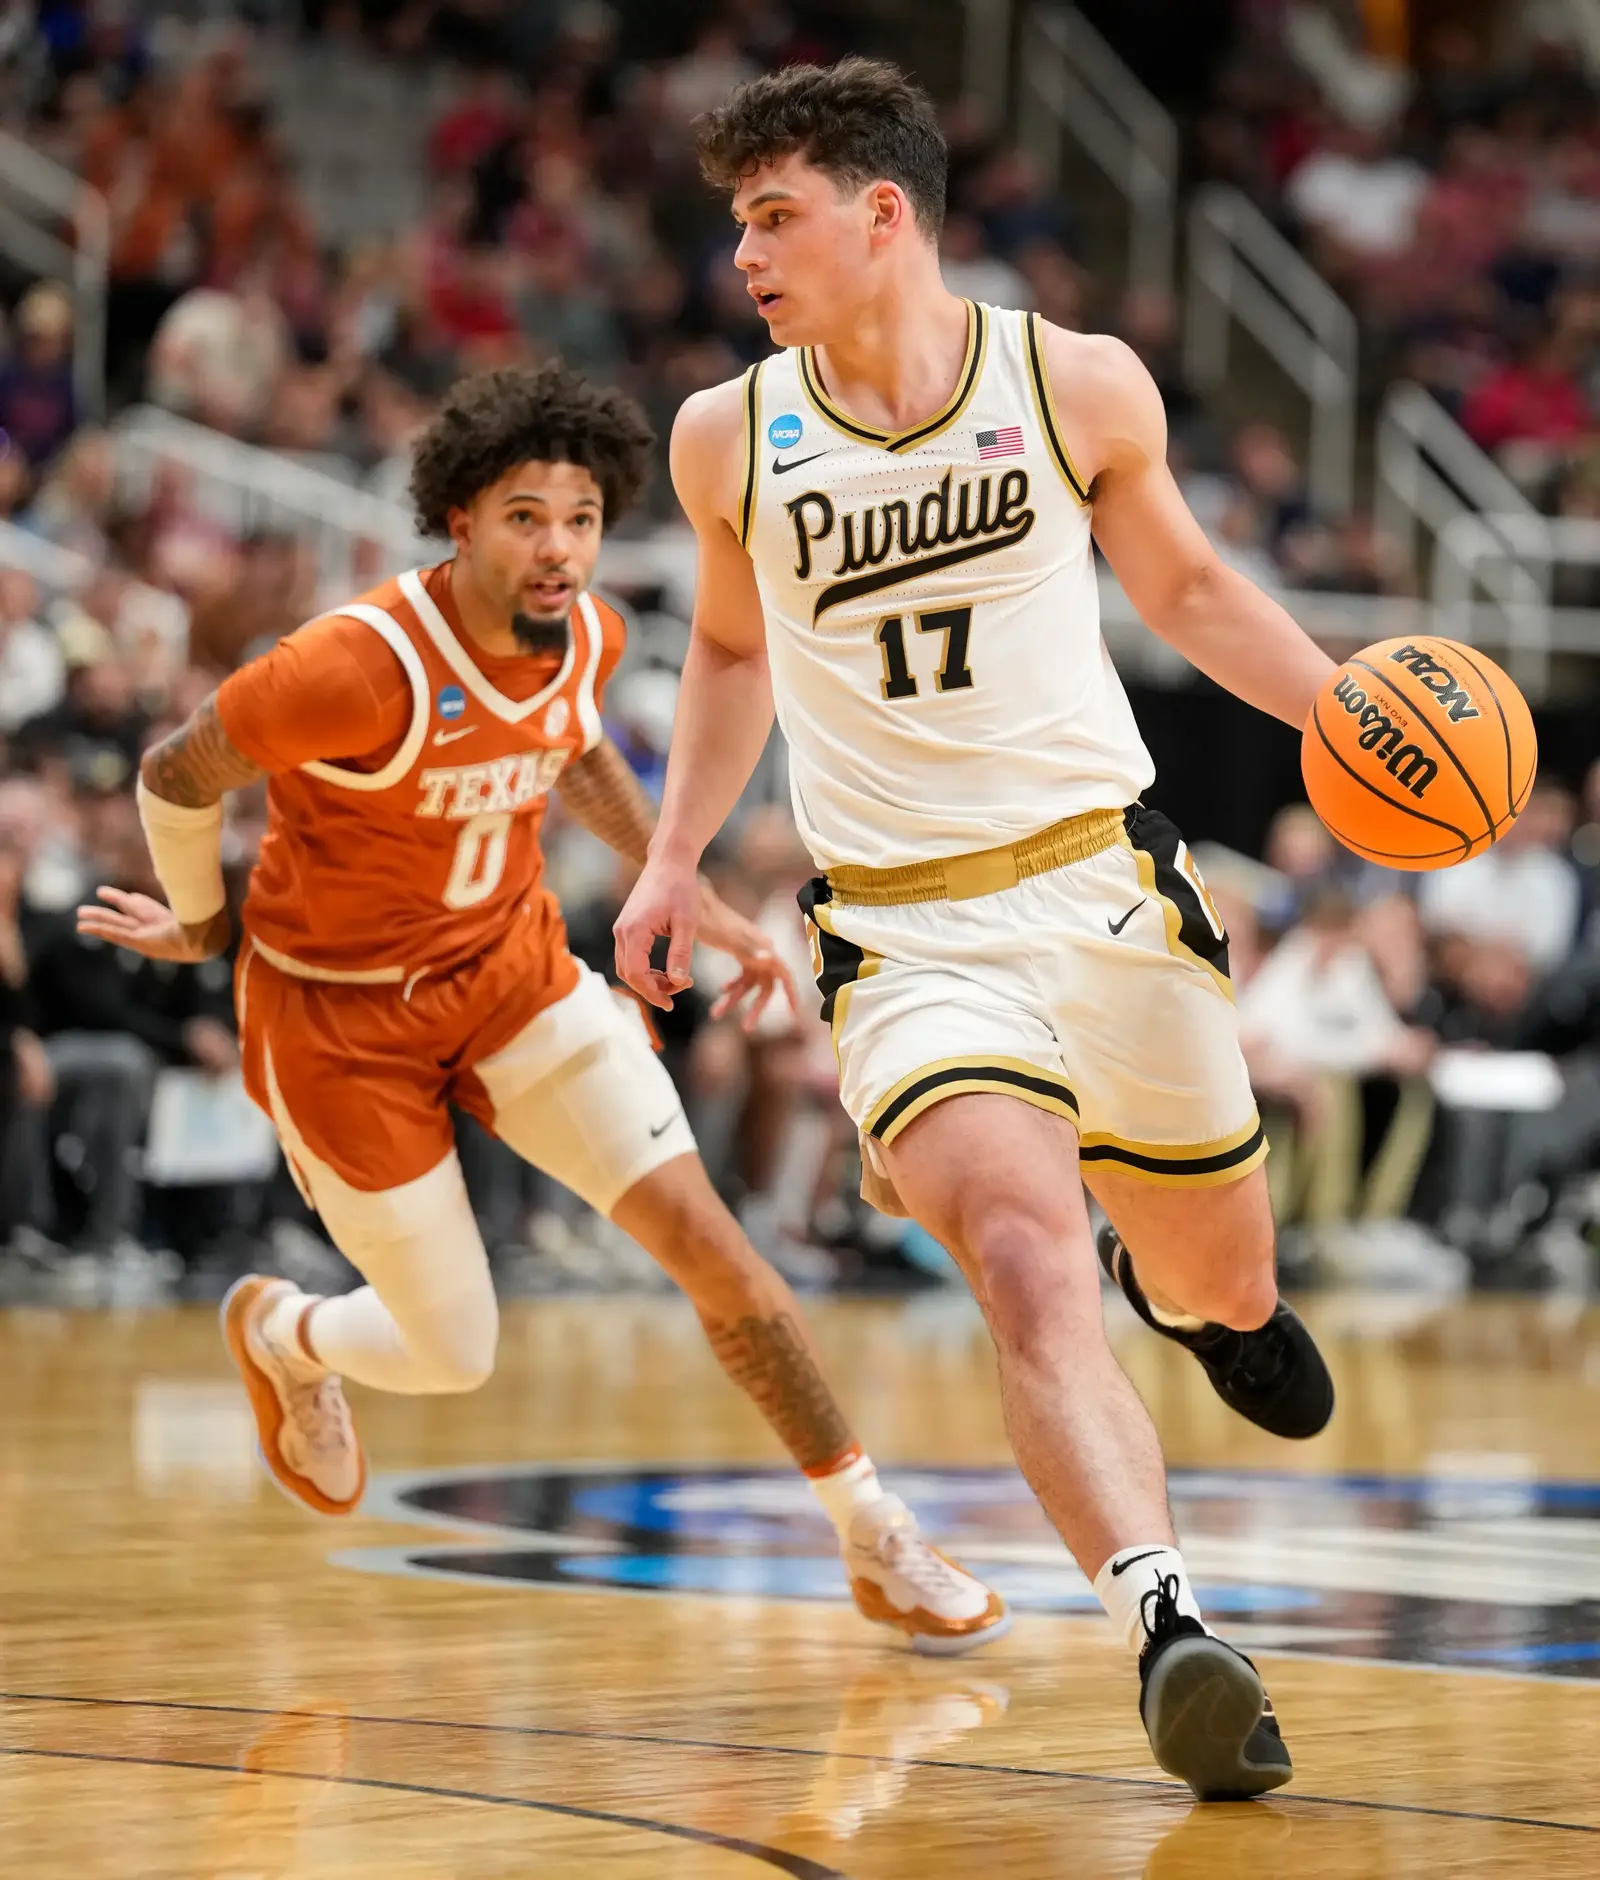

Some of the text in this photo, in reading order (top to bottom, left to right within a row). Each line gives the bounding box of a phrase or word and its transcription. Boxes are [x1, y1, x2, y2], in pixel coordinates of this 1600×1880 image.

[772, 429, 800, 439] NCAA
[783, 465, 1036, 630] Purdue
[874, 603, 974, 701] 17
[1388, 644, 1481, 724] NCAA
[1333, 672, 1439, 800] Wilson
[1374, 694, 1408, 727] EVO NXT
[415, 747, 572, 820] TEXAS
[442, 813, 514, 912] 0
